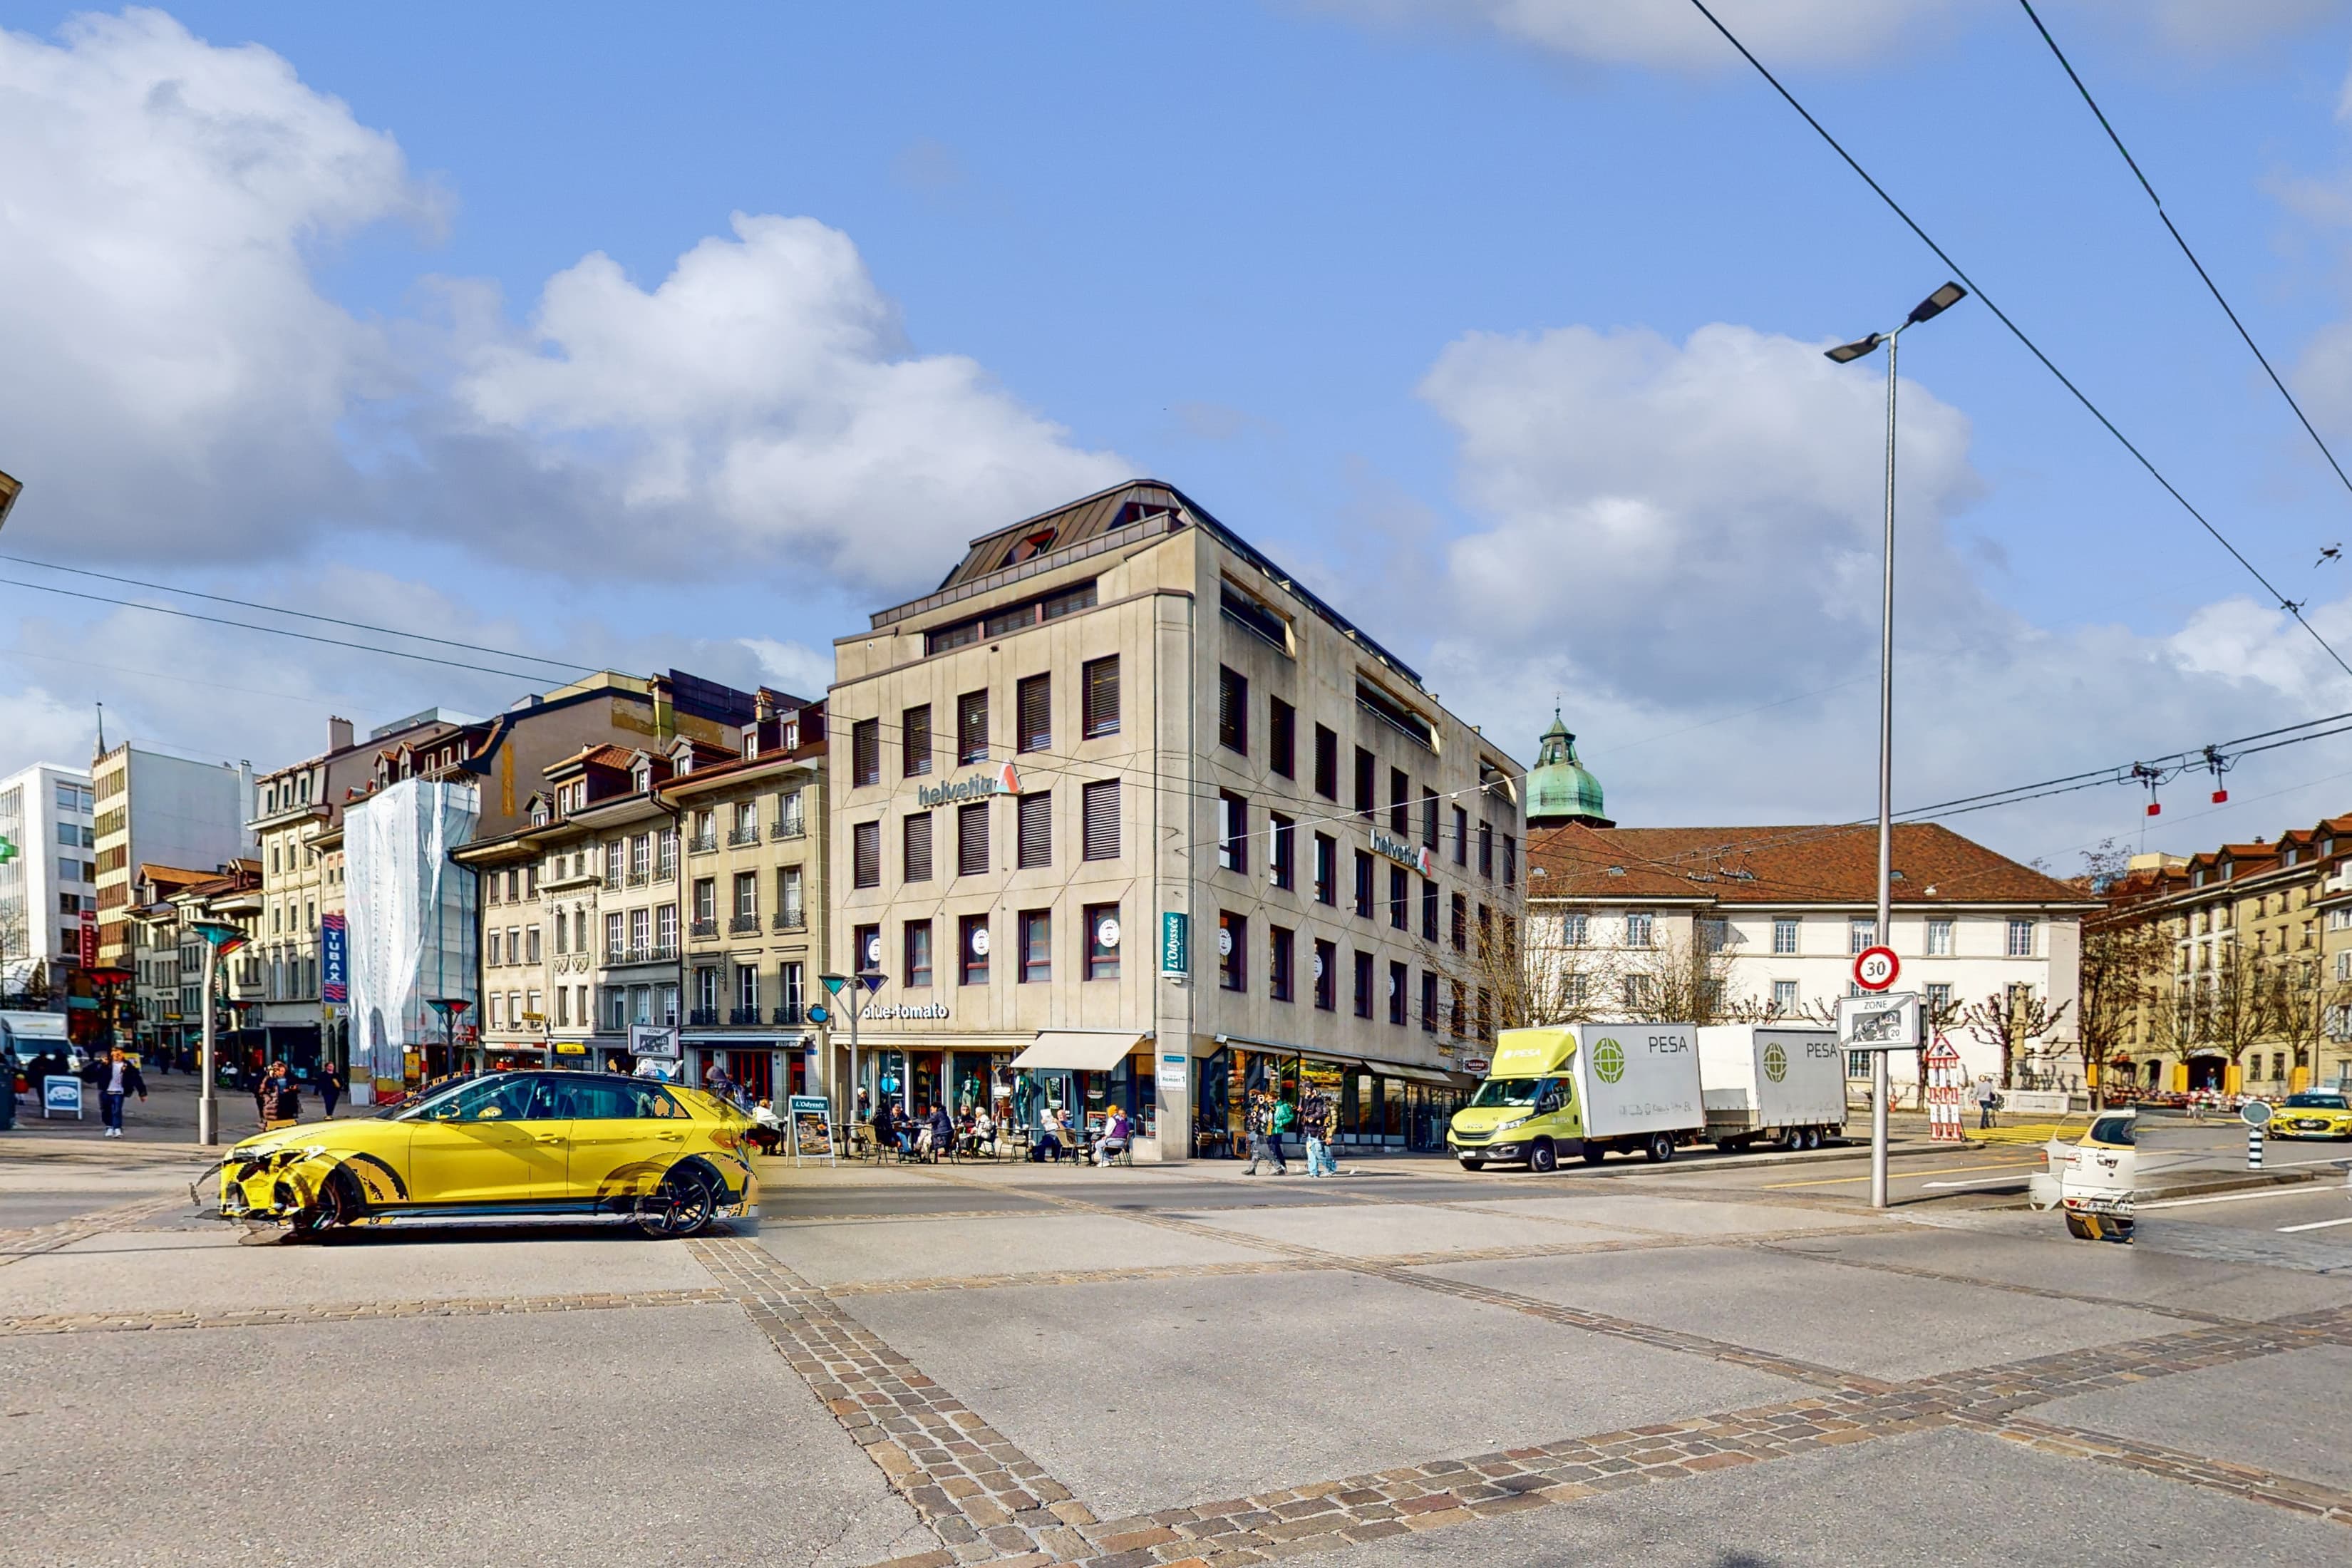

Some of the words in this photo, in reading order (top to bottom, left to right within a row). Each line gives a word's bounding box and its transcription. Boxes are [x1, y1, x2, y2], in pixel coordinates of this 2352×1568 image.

[918, 773, 993, 806] helvetia
[1370, 829, 1418, 868] helvetia
[1166, 917, 1180, 969] L'Odyssée
[329, 932, 340, 981] TUBAX
[1867, 961, 1886, 976] 30
[1864, 1000, 1887, 1010] ZONE
[1649, 1036, 1688, 1053] PESA
[1807, 1043, 1838, 1058] PESA
